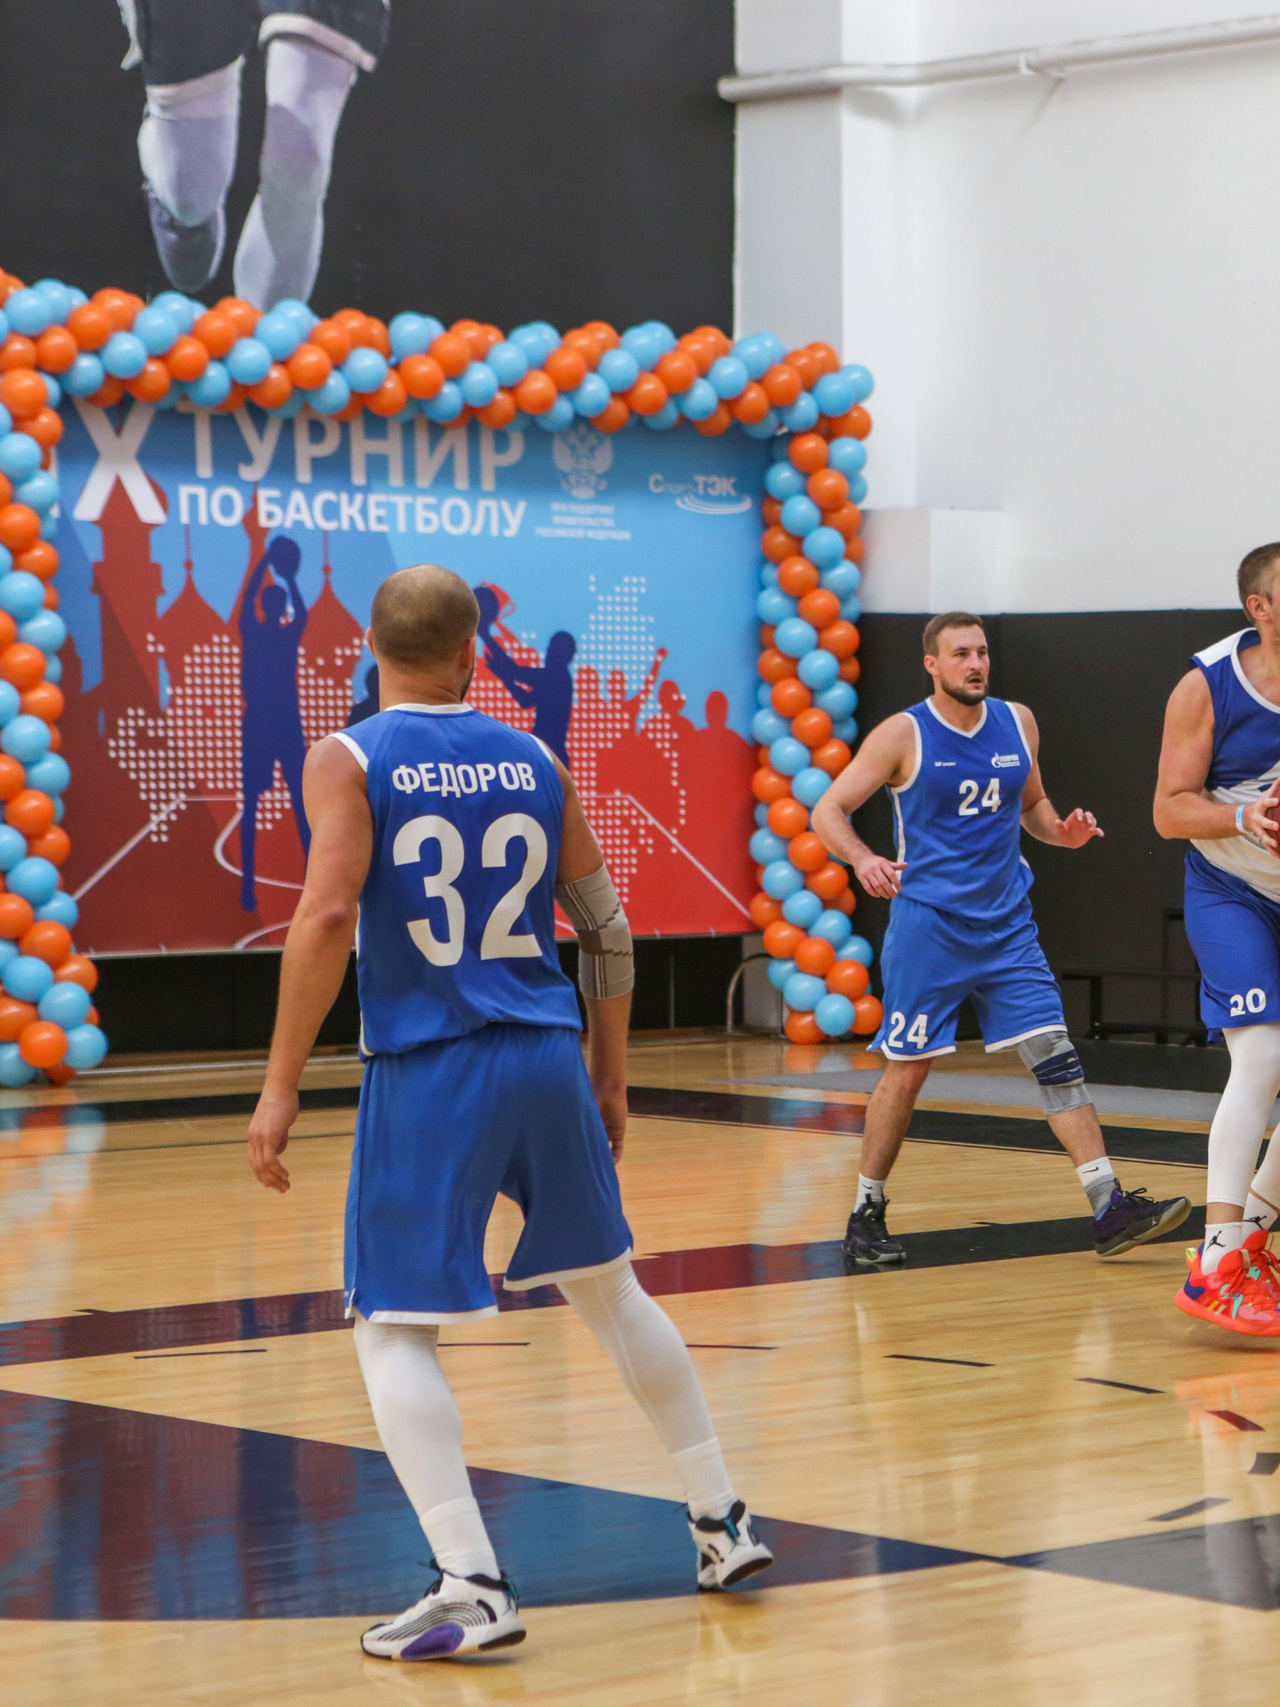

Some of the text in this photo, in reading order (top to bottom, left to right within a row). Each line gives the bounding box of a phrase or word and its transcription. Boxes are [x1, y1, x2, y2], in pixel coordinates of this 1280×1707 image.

[176, 400, 525, 492] ТУРНИР
[178, 484, 528, 538] ПО БАСКЕТБОЛУ
[392, 762, 537, 798] ФЕДОРОВ
[959, 778, 1001, 816] 24
[393, 812, 548, 967] 32
[1229, 987, 1267, 1017] 20
[888, 1011, 929, 1050] 24
